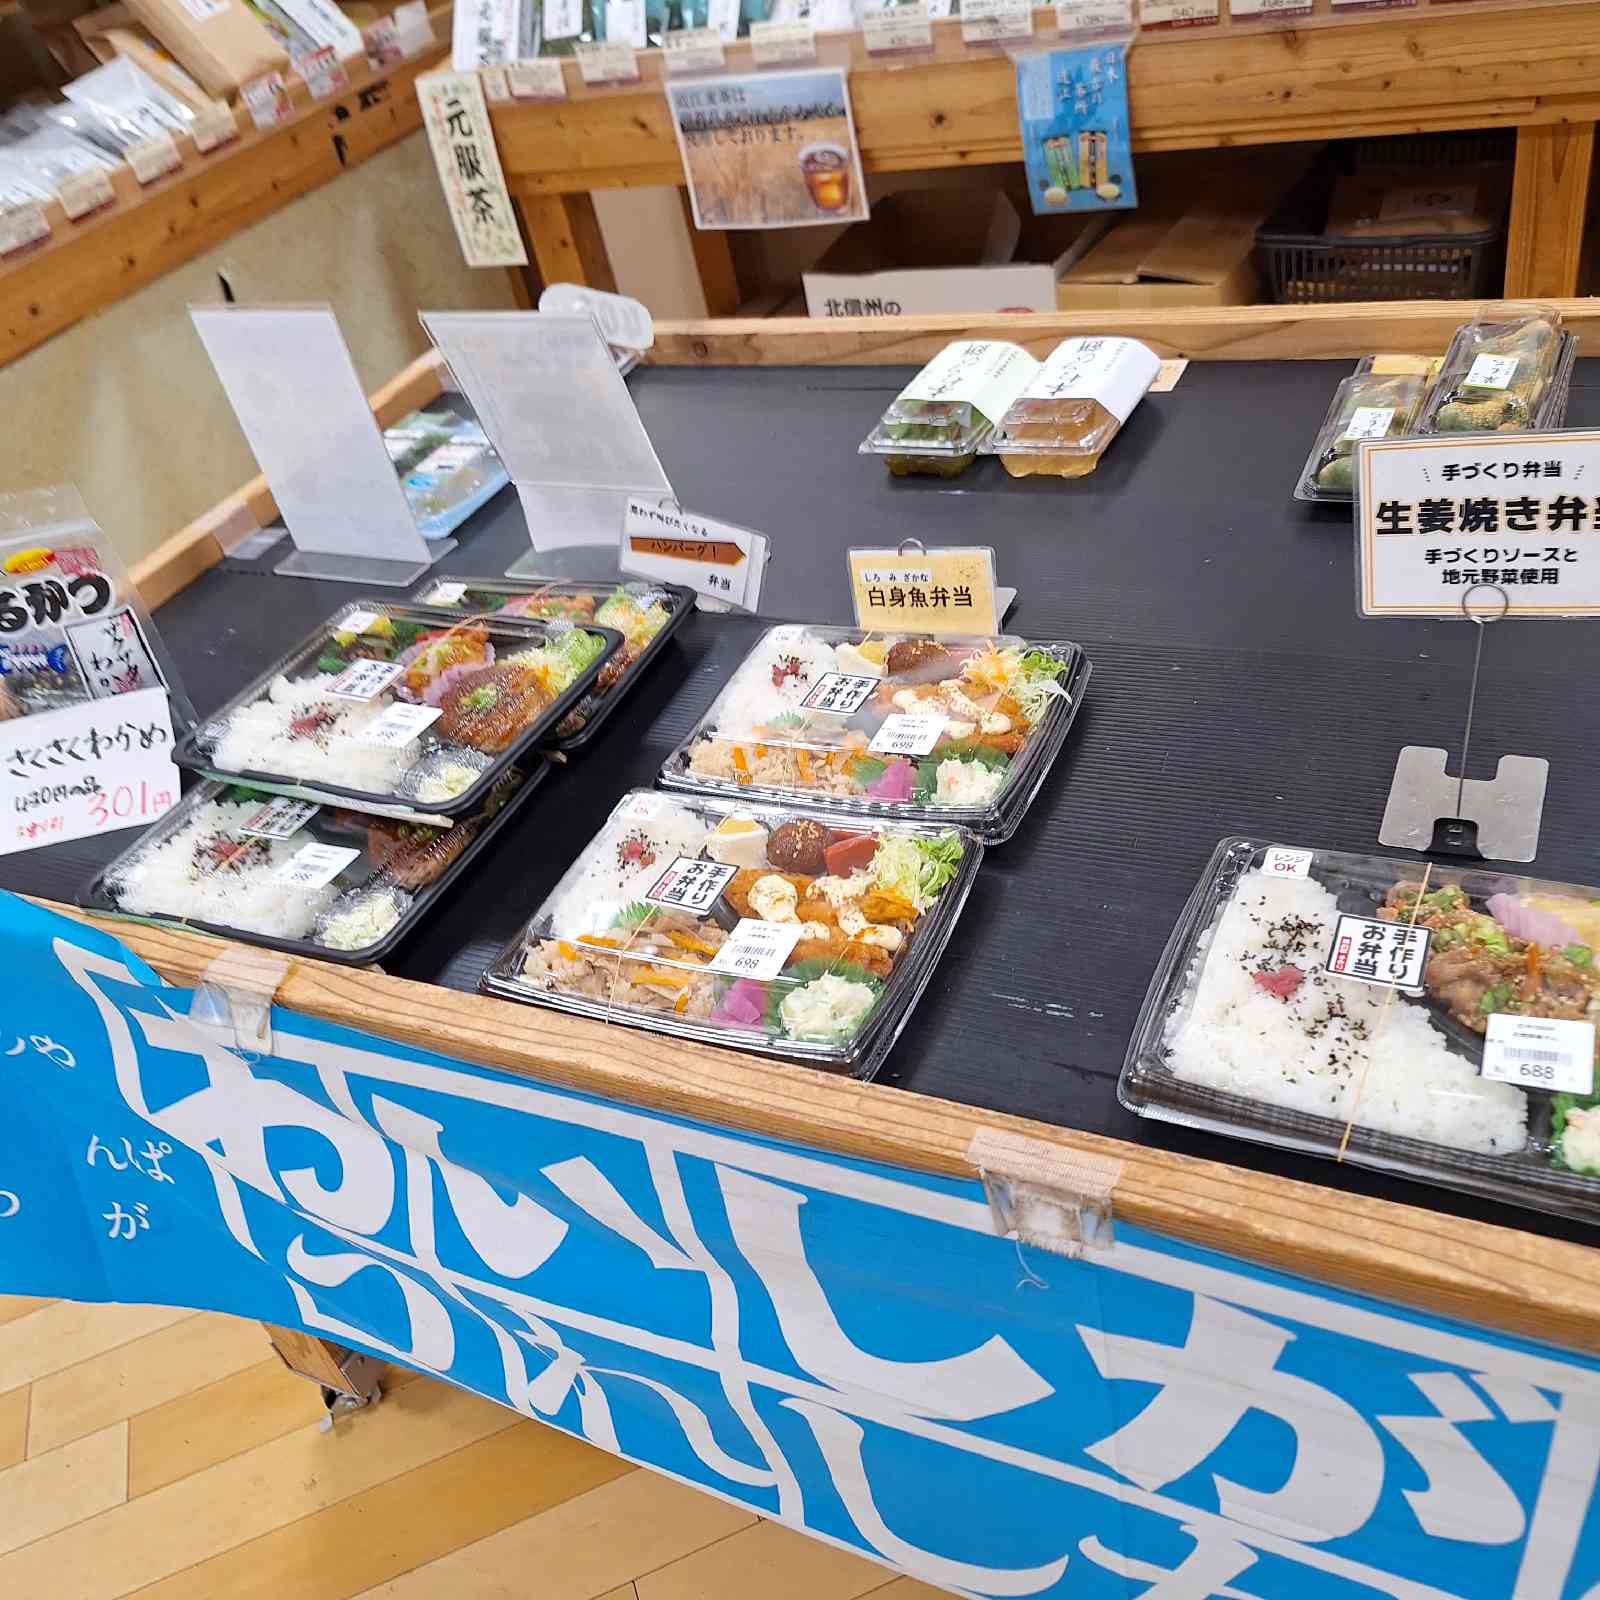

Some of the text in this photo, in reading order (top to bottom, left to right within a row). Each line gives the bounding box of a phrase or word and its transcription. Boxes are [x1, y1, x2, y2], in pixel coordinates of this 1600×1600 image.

[446, 99, 496, 223] 元服茶
[824, 297, 902, 317] 北信州の
[1441, 460, 1562, 481] 手づくり弁当
[1376, 495, 1600, 536] 生姜焼き弁
[1424, 547, 1578, 565] 手づくりソースと
[708, 574, 732, 591] 弁当
[1441, 568, 1560, 586] 地元野菜使用
[867, 585, 974, 609] 白身魚弁当
[818, 676, 853, 708] お弁当
[840, 679, 871, 708] 手作り
[6, 721, 168, 778] さくさくわかめ
[1274, 863, 1297, 873] OK
[664, 863, 708, 902] お弁当
[691, 865, 728, 905] 手作り
[735, 957, 760, 969] 698
[1352, 924, 1387, 977] お弁当
[1388, 928, 1417, 980] 手作り
[1519, 1063, 1555, 1080] 688
